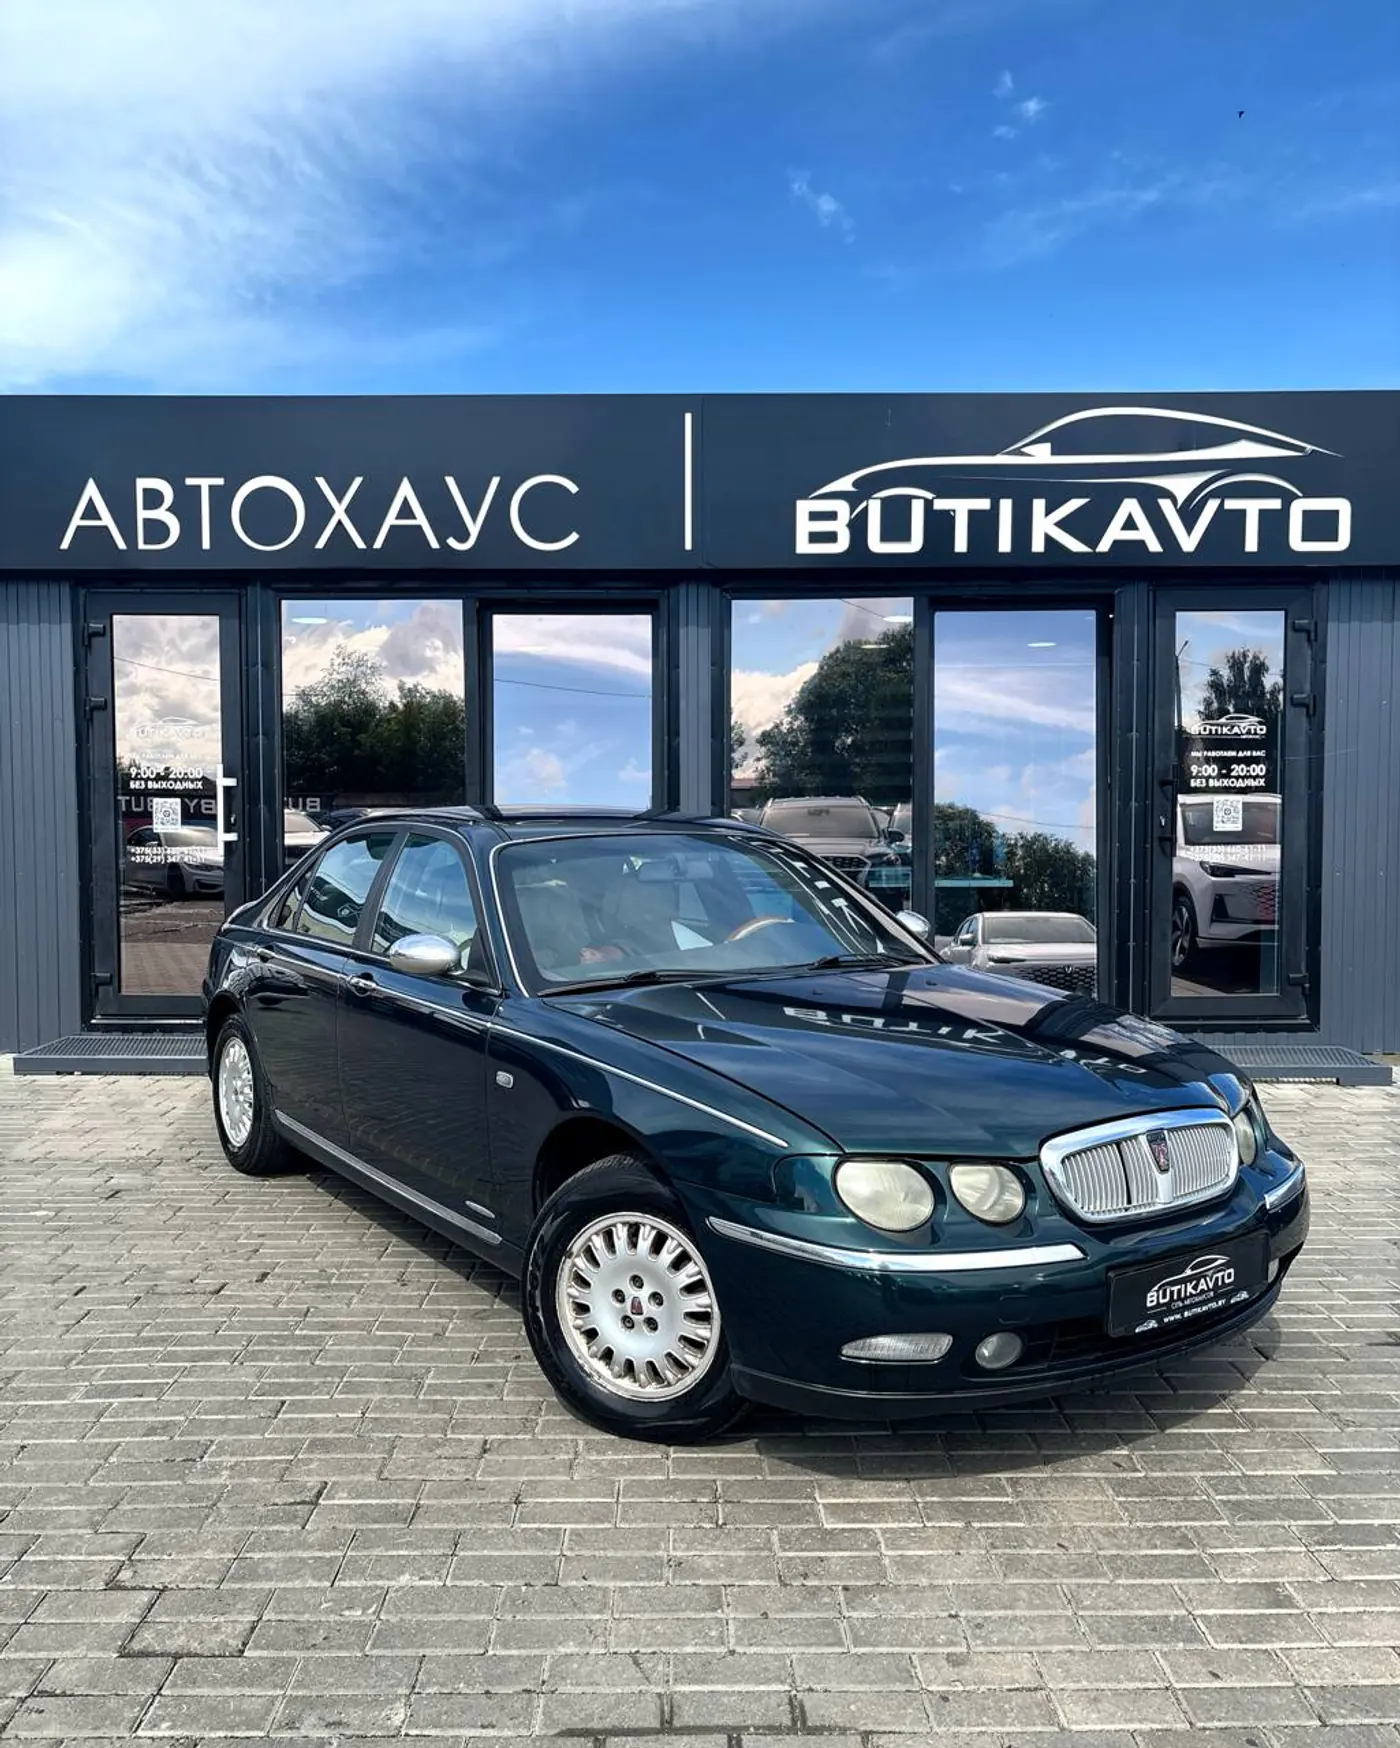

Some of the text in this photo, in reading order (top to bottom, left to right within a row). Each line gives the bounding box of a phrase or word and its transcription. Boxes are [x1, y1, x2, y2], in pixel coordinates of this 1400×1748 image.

[59, 474, 580, 552] АВТОХАУС
[795, 496, 1353, 555] BUTIKAVTO
[1190, 725, 1267, 735] BUTIKAVTO
[130, 767, 156, 778] 9:00
[168, 767, 204, 778] 20:00
[1190, 764, 1218, 776] 9:00
[1230, 764, 1266, 776] 20:00
[129, 780, 203, 790] БЕЗ ВЫХОДНЫХ
[1190, 778, 1266, 788] БЕЗ ВЫХОДНЫХ
[1146, 1268, 1235, 1308] BUTIKAVTO
